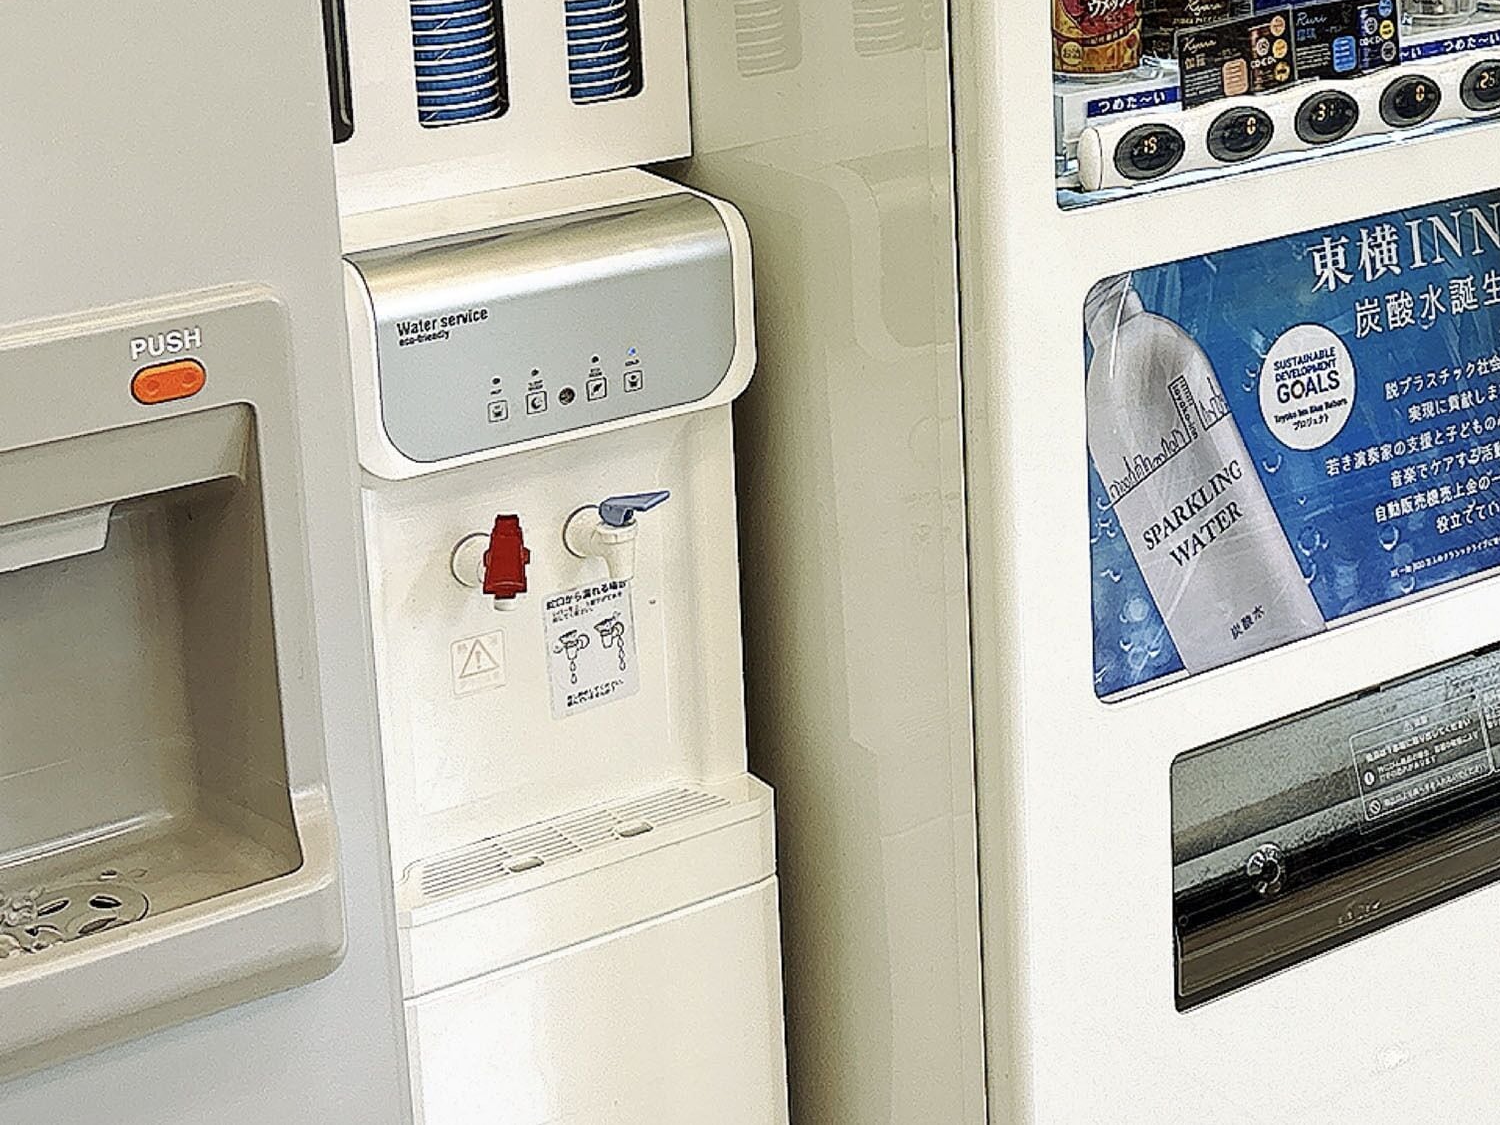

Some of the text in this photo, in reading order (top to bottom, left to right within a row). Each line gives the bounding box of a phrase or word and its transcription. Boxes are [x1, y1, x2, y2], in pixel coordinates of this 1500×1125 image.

[397, 308, 489, 337] Water service
[131, 327, 202, 361] PUSH
[1273, 346, 1336, 371] SUSTAINABLE
[1275, 358, 1337, 383] DEVELOPMENT
[1277, 370, 1341, 404] GOALS
[1143, 460, 1244, 551] SPARKLING
[1169, 501, 1244, 567] WATER
